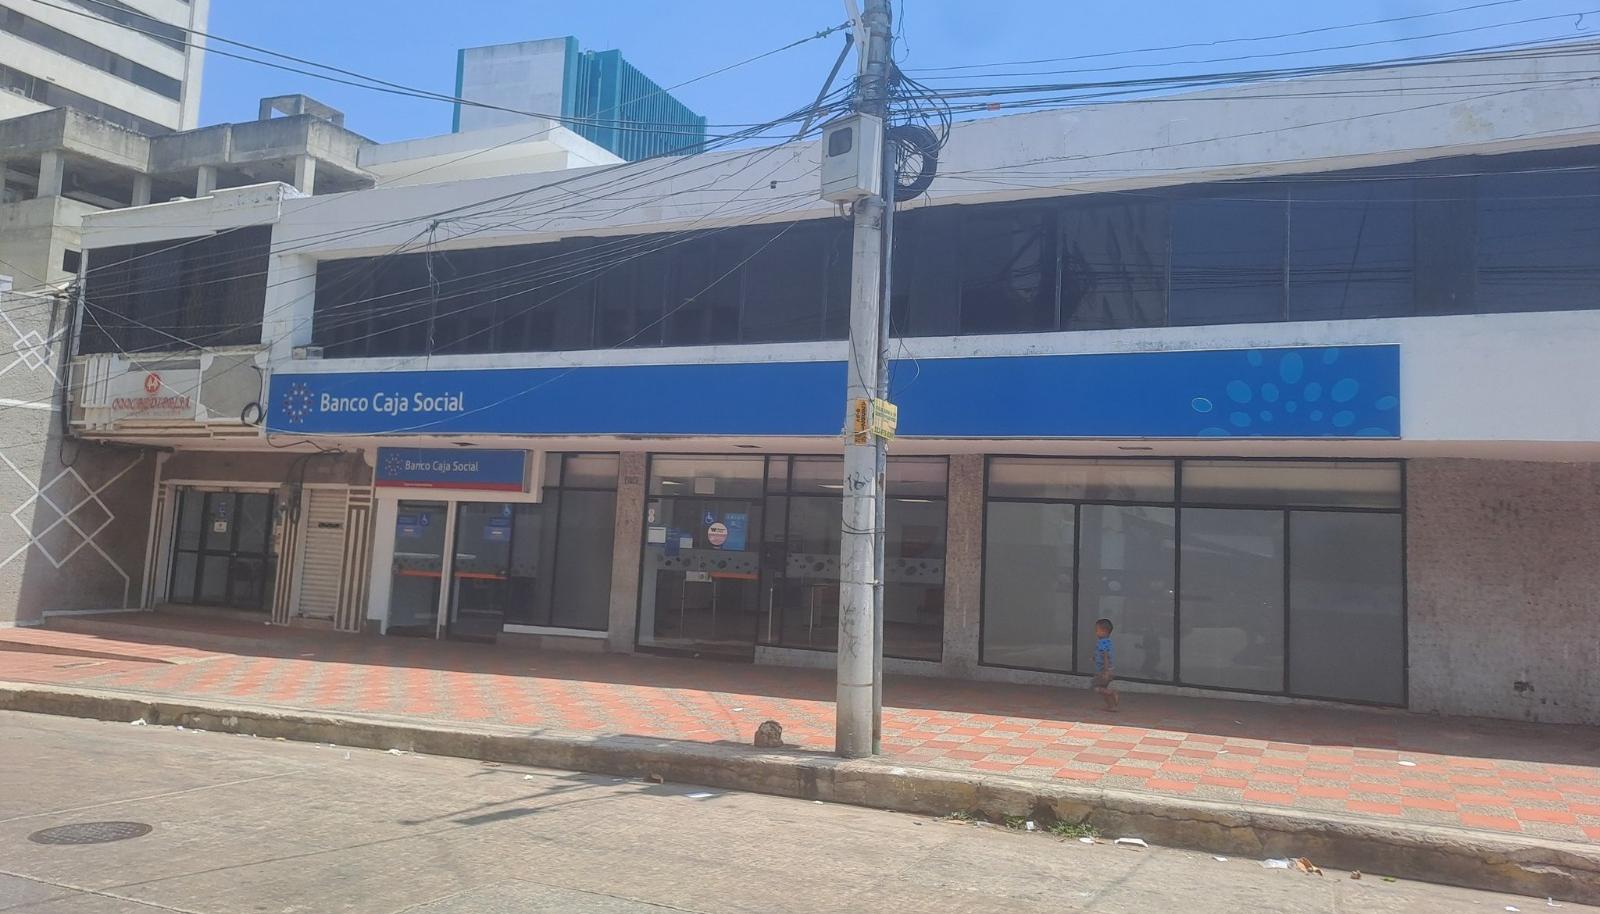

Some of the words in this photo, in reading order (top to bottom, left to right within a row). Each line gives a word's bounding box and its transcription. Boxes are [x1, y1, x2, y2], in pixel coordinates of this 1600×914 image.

[320, 392, 368, 412] Banco
[372, 391, 409, 416] Caja
[412, 391, 464, 412] Social
[404, 460, 431, 472] Banco
[432, 460, 451, 474] Caja
[452, 460, 479, 473] Social
